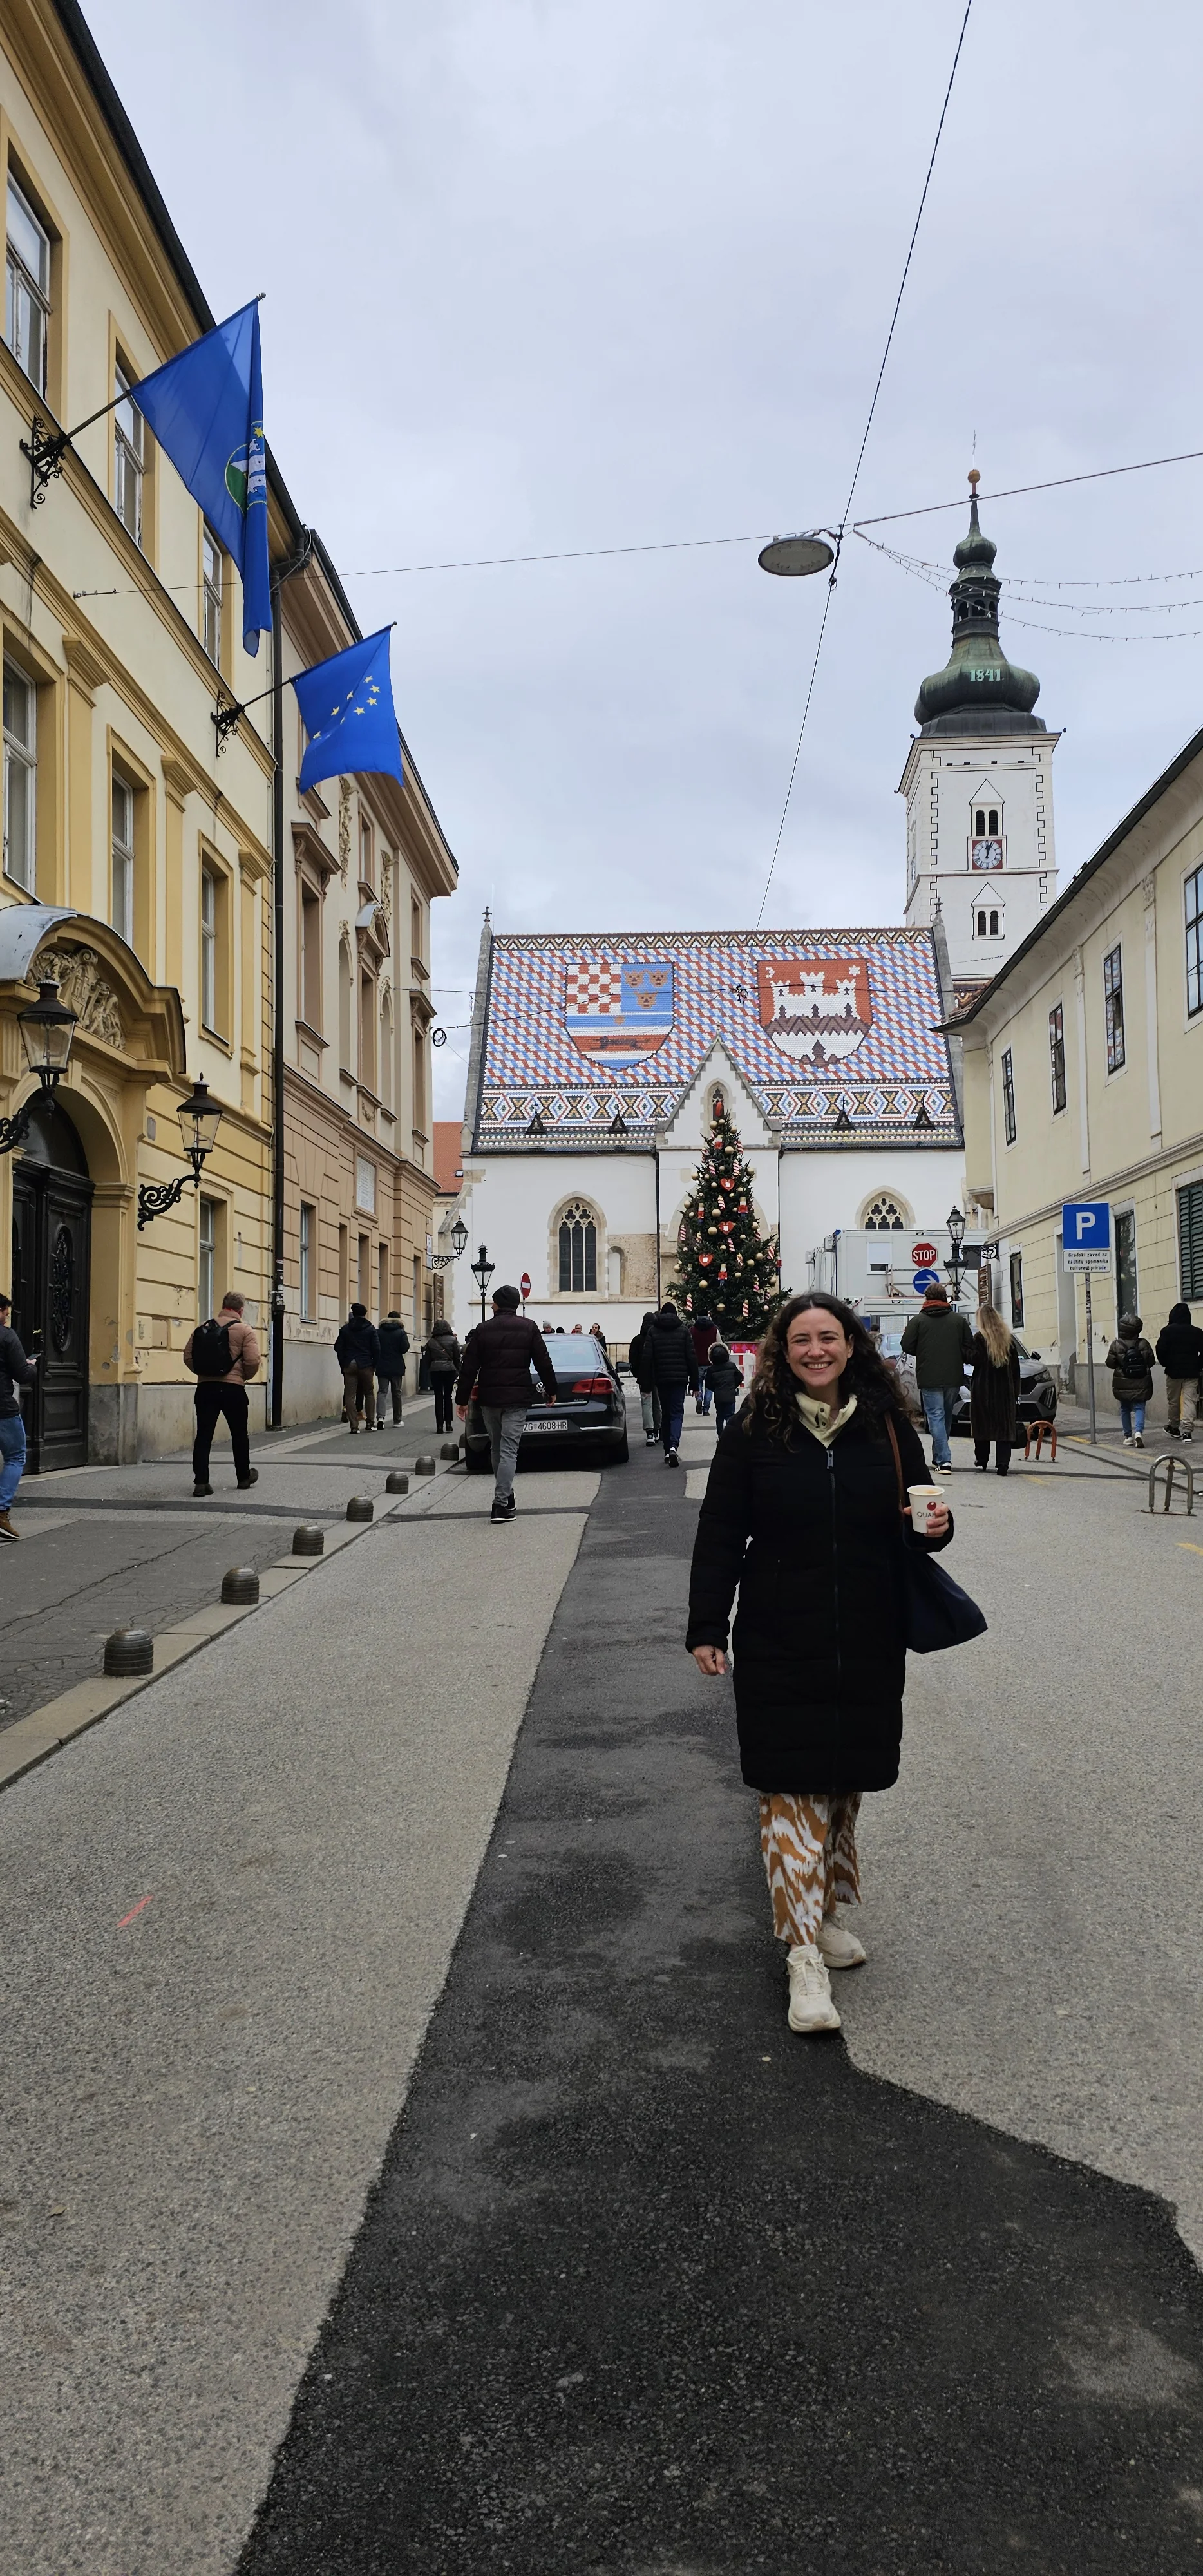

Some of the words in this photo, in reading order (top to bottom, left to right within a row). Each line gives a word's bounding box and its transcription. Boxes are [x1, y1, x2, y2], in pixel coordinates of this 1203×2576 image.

[1076, 1212, 1095, 1240] P
[913, 1249, 935, 1261] STOP
[524, 1423, 533, 1431] ZG
